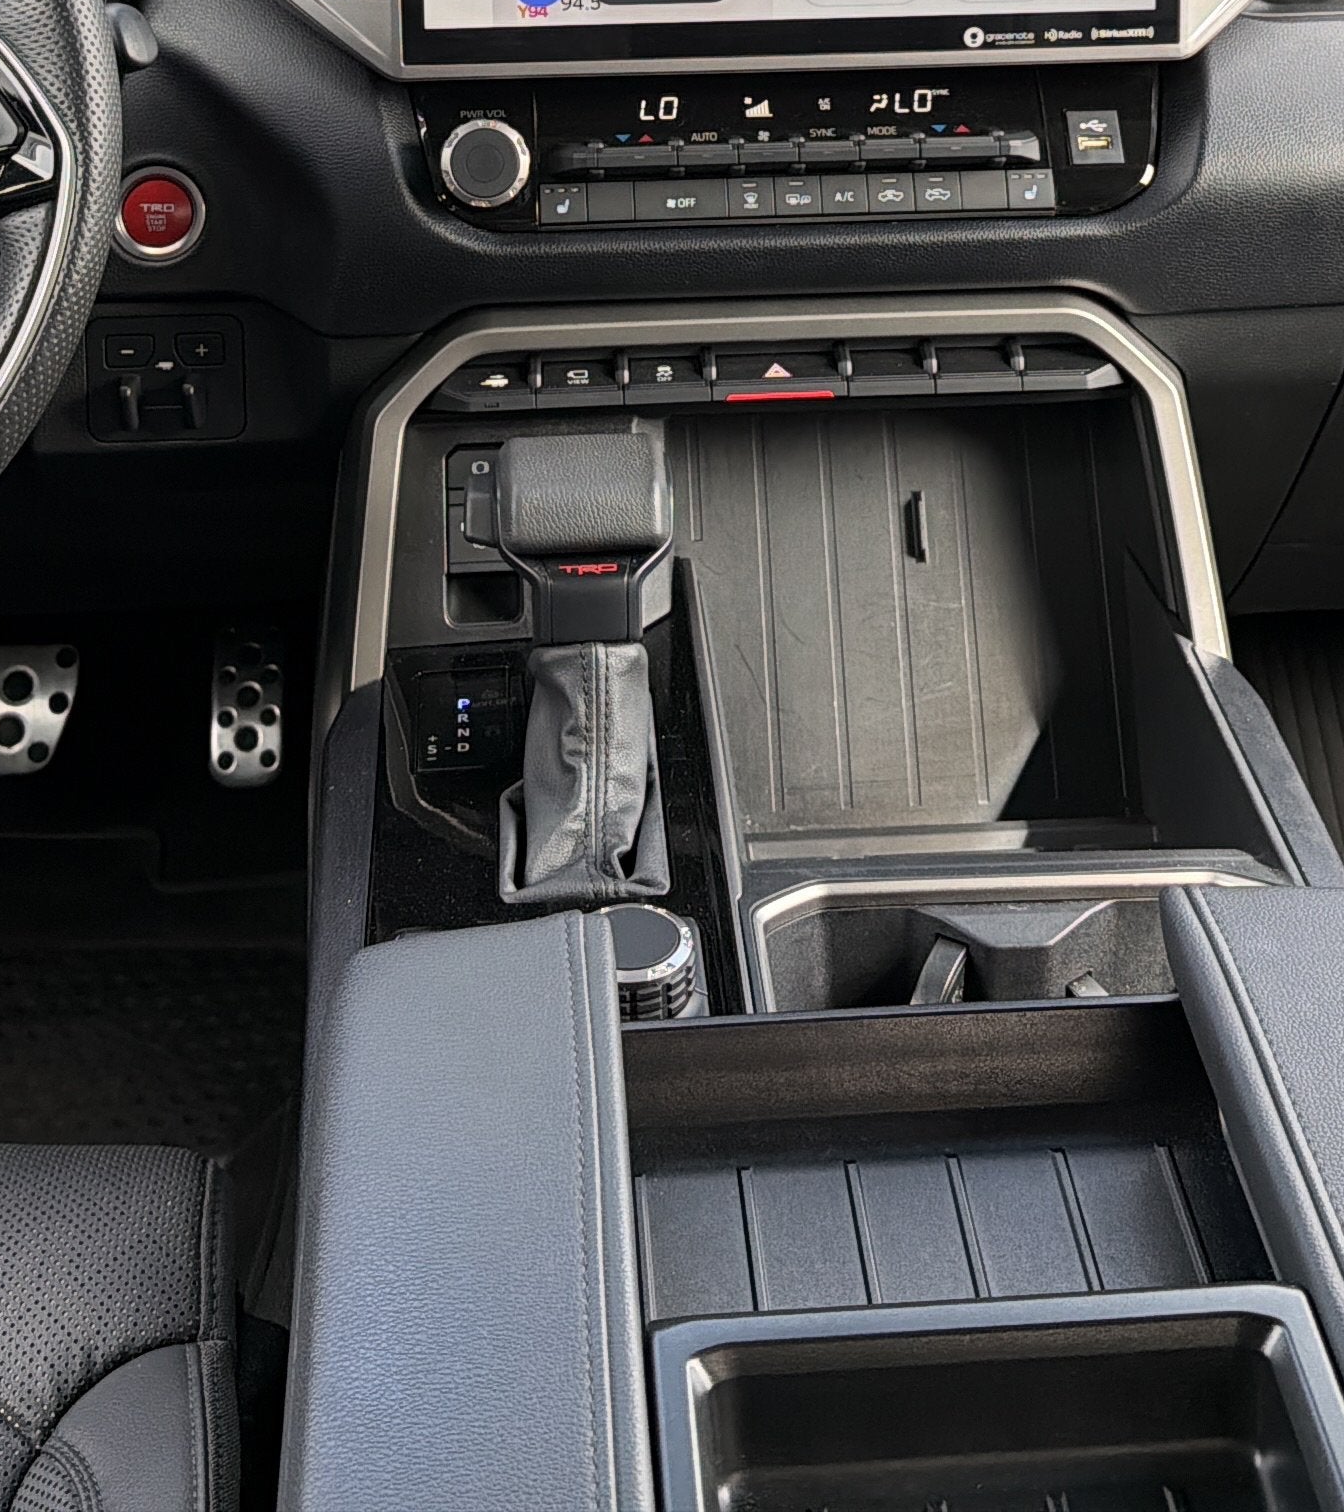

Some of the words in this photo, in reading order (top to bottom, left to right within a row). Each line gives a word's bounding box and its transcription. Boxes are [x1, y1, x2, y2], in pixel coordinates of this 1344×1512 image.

[517, 5, 549, 19] Y94
[985, 30, 1035, 43] gracenote
[1058, 29, 1083, 40] Radio
[460, 110, 484, 119] PWR
[486, 110, 507, 119] VOL
[690, 131, 718, 142] AUTO
[809, 127, 837, 138] SYNC
[867, 126, 897, 136] MODE
[834, 191, 855, 203] A/C
[139, 203, 175, 213] TRD
[677, 197, 697, 210] OFF
[558, 563, 618, 575] TRD
[457, 698, 471, 709] P
[457, 714, 470, 723] R
[457, 728, 470, 737] N
[427, 745, 437, 754] S
[457, 743, 470, 752] D
